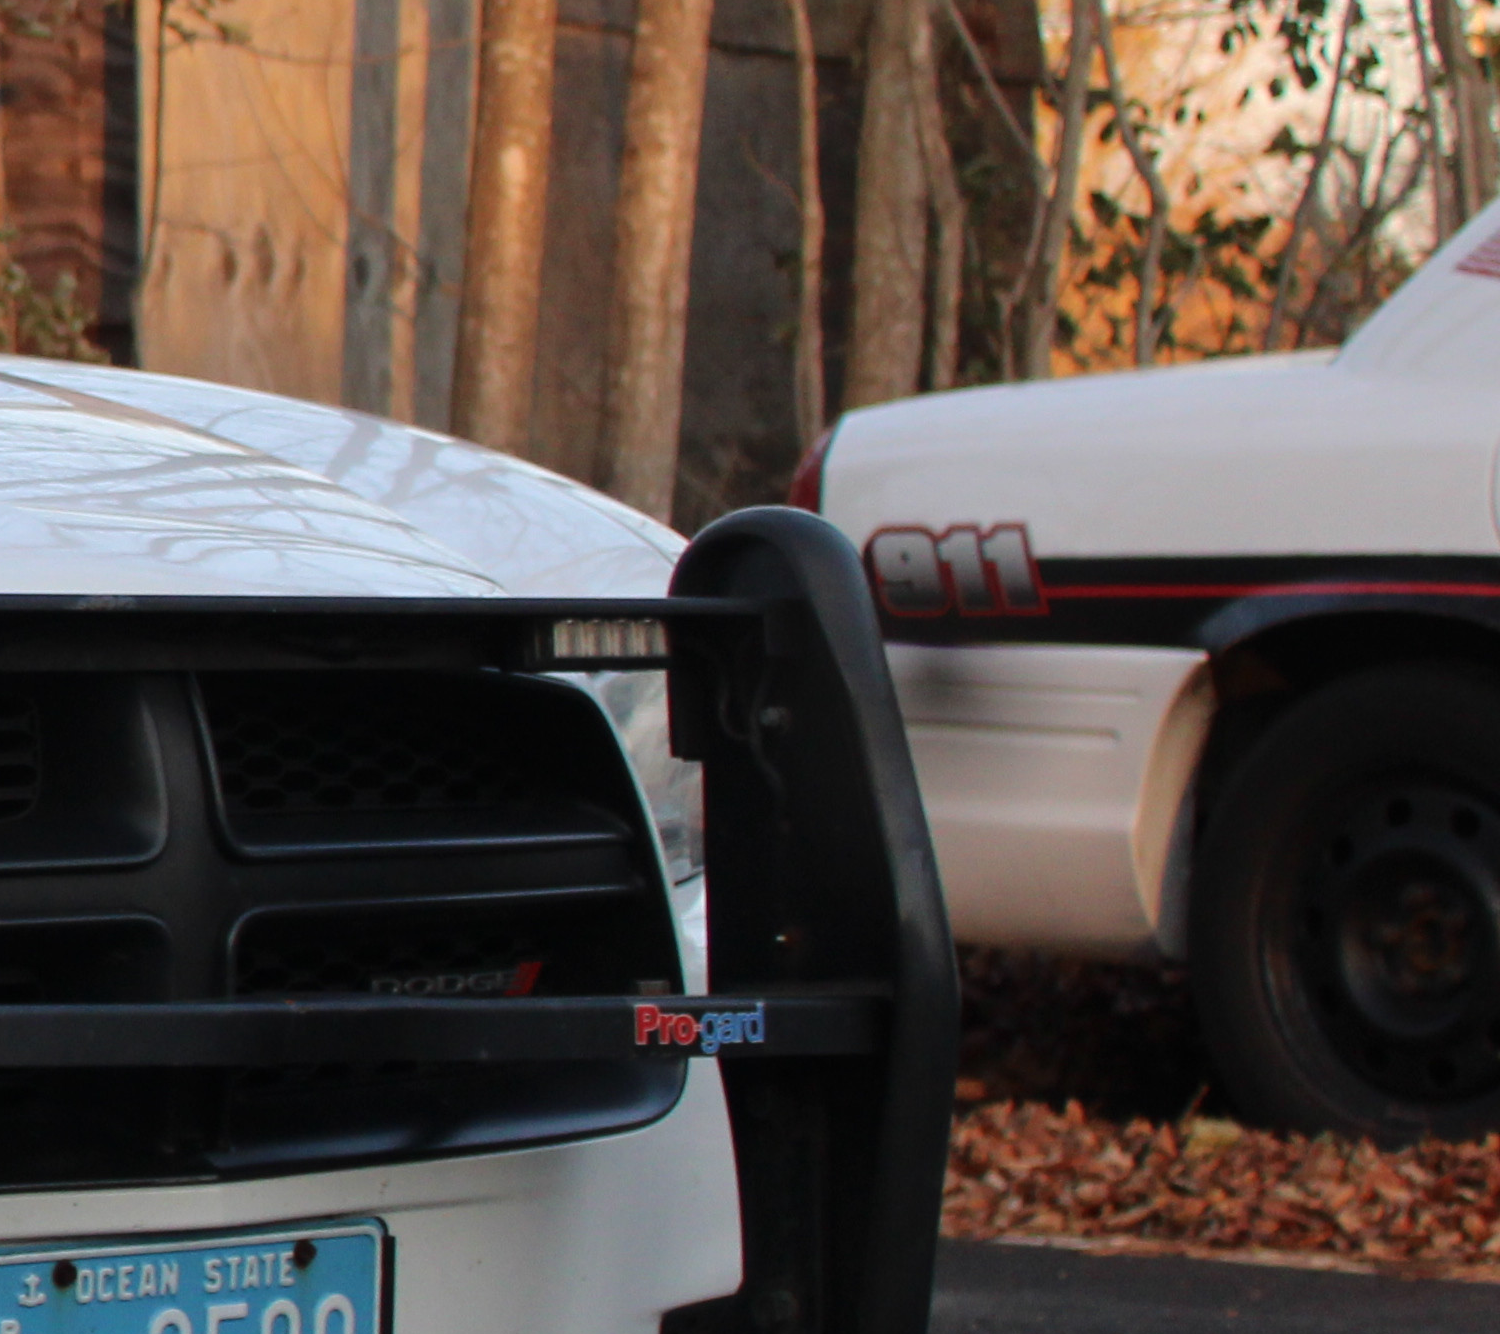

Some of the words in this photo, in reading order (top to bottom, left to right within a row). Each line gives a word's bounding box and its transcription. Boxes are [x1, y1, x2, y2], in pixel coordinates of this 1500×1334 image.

[863, 522, 1050, 617] 911
[634, 1001, 766, 1055] Pro-gard
[74, 1260, 180, 1304] OCEAN
[204, 1250, 296, 1294] STATE
